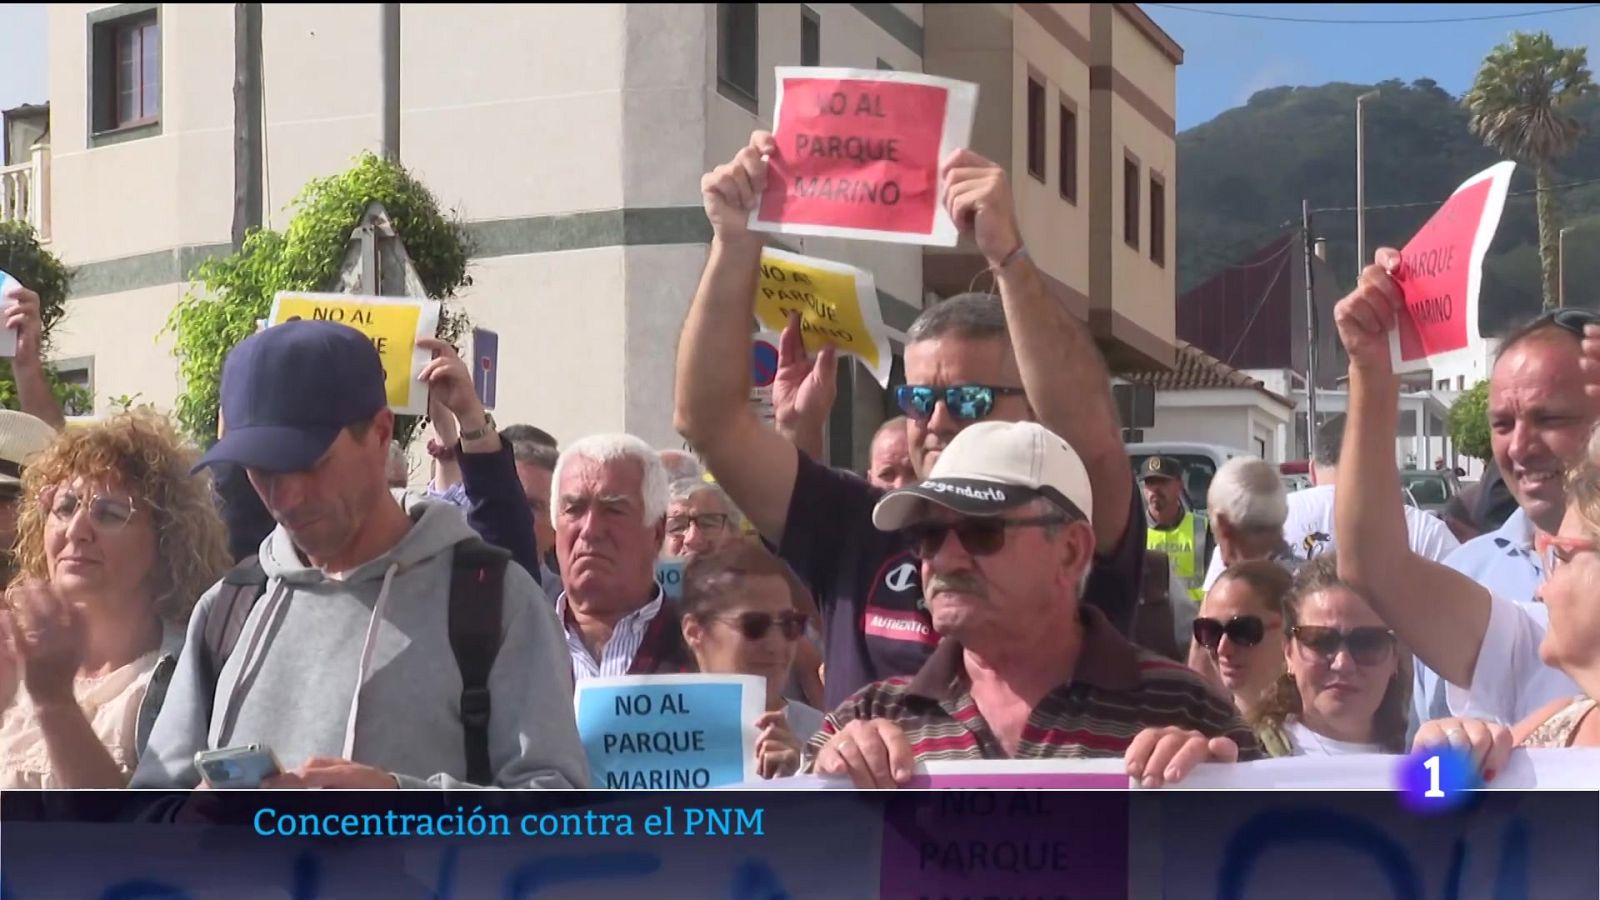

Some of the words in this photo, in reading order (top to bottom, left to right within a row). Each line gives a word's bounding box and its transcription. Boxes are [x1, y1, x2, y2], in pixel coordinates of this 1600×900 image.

[855, 93, 887, 118] AL
[795, 133, 899, 164] PARQUE
[795, 176, 900, 206] MARINO
[312, 307, 344, 321] NO
[778, 307, 853, 342] MRINO
[615, 694, 651, 716] NO
[660, 693, 690, 715] AL
[603, 730, 706, 756] PARQUE
[606, 768, 711, 789] MARINO
[919, 840, 1070, 874] PARQUE
